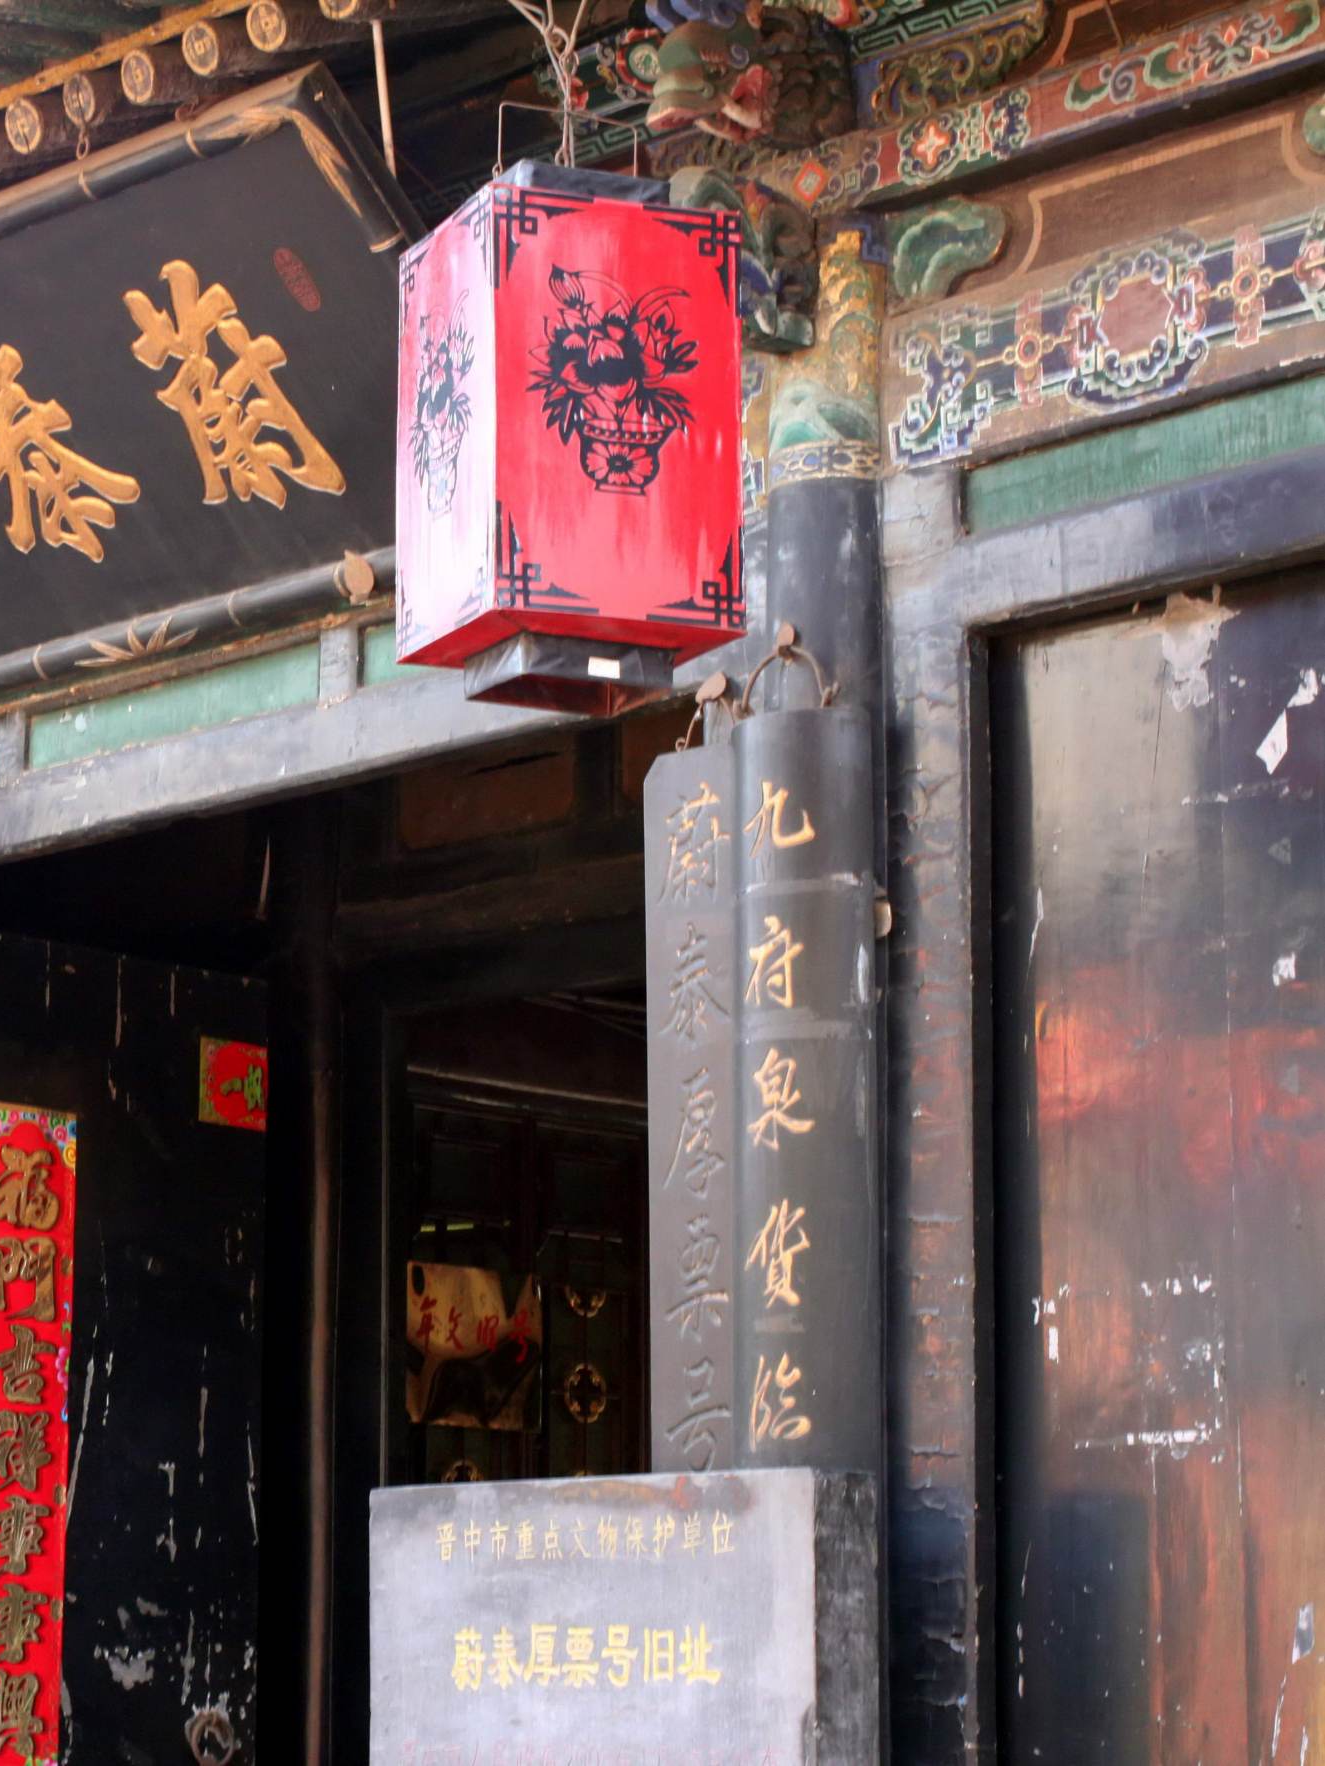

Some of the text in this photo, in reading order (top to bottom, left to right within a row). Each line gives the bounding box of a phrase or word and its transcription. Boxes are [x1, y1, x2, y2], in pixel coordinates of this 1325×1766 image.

[451, 1623, 722, 1691] 蔚泰厚票号旧址
